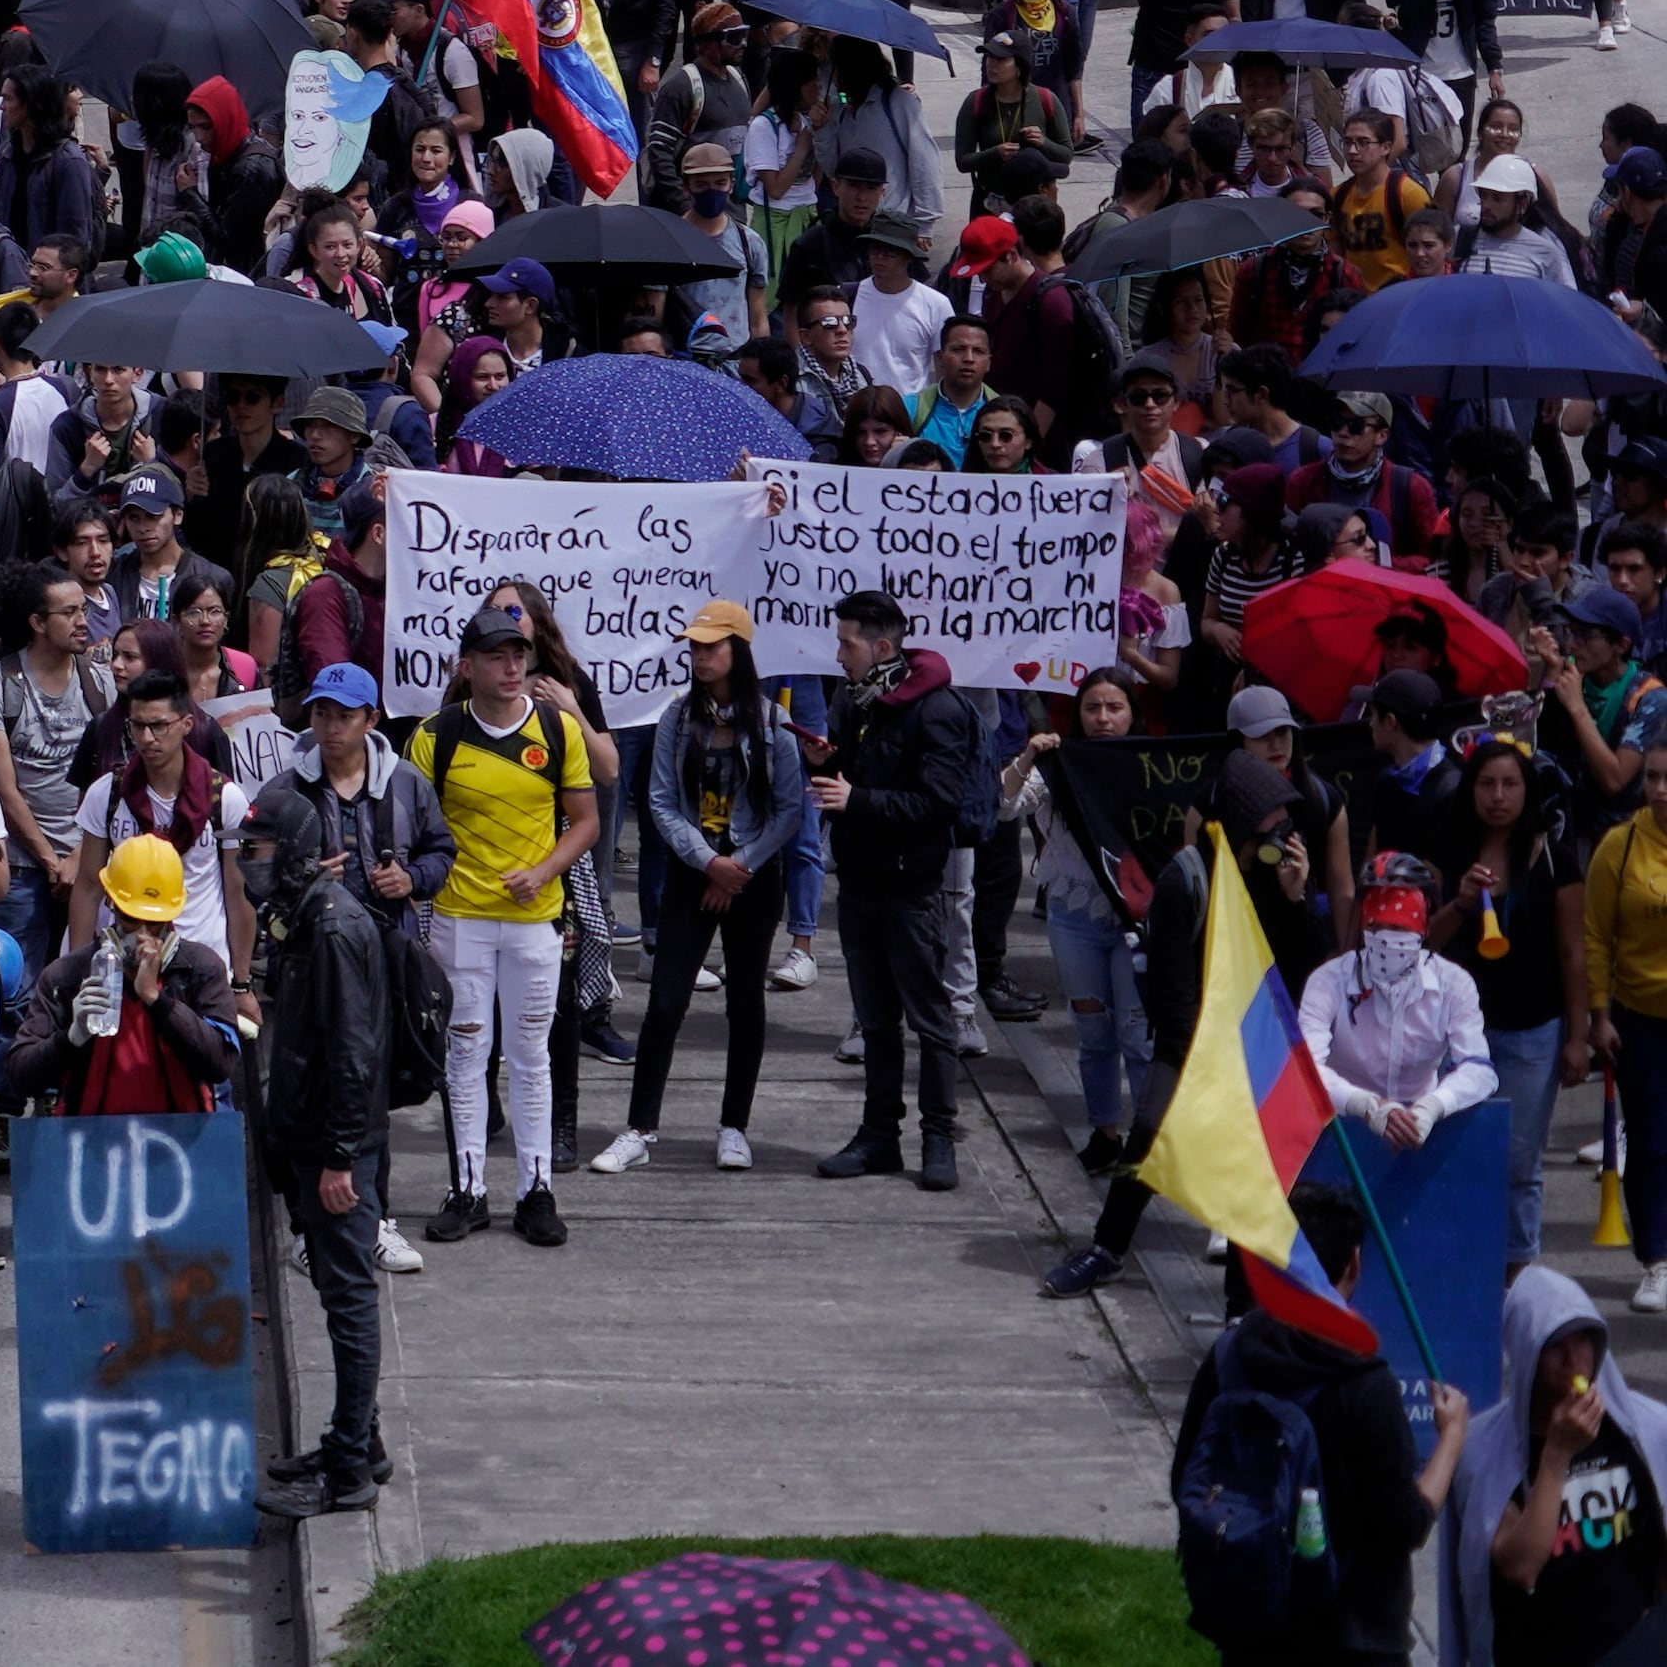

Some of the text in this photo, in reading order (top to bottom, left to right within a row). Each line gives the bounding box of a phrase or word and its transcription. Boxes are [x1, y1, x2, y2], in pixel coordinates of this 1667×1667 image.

[813, 471, 1112, 523] el estado fuera
[638, 504, 691, 554] las
[759, 516, 1117, 569] justo todo el tiempo
[539, 566, 720, 611] que quieran
[764, 559, 1094, 603] yo no lucharía ni
[403, 595, 687, 639] más balas
[942, 600, 1116, 642] la marcha
[588, 650, 692, 695] IDEAS
[1048, 659, 1089, 688] UD
[70, 1122, 191, 1237] UD
